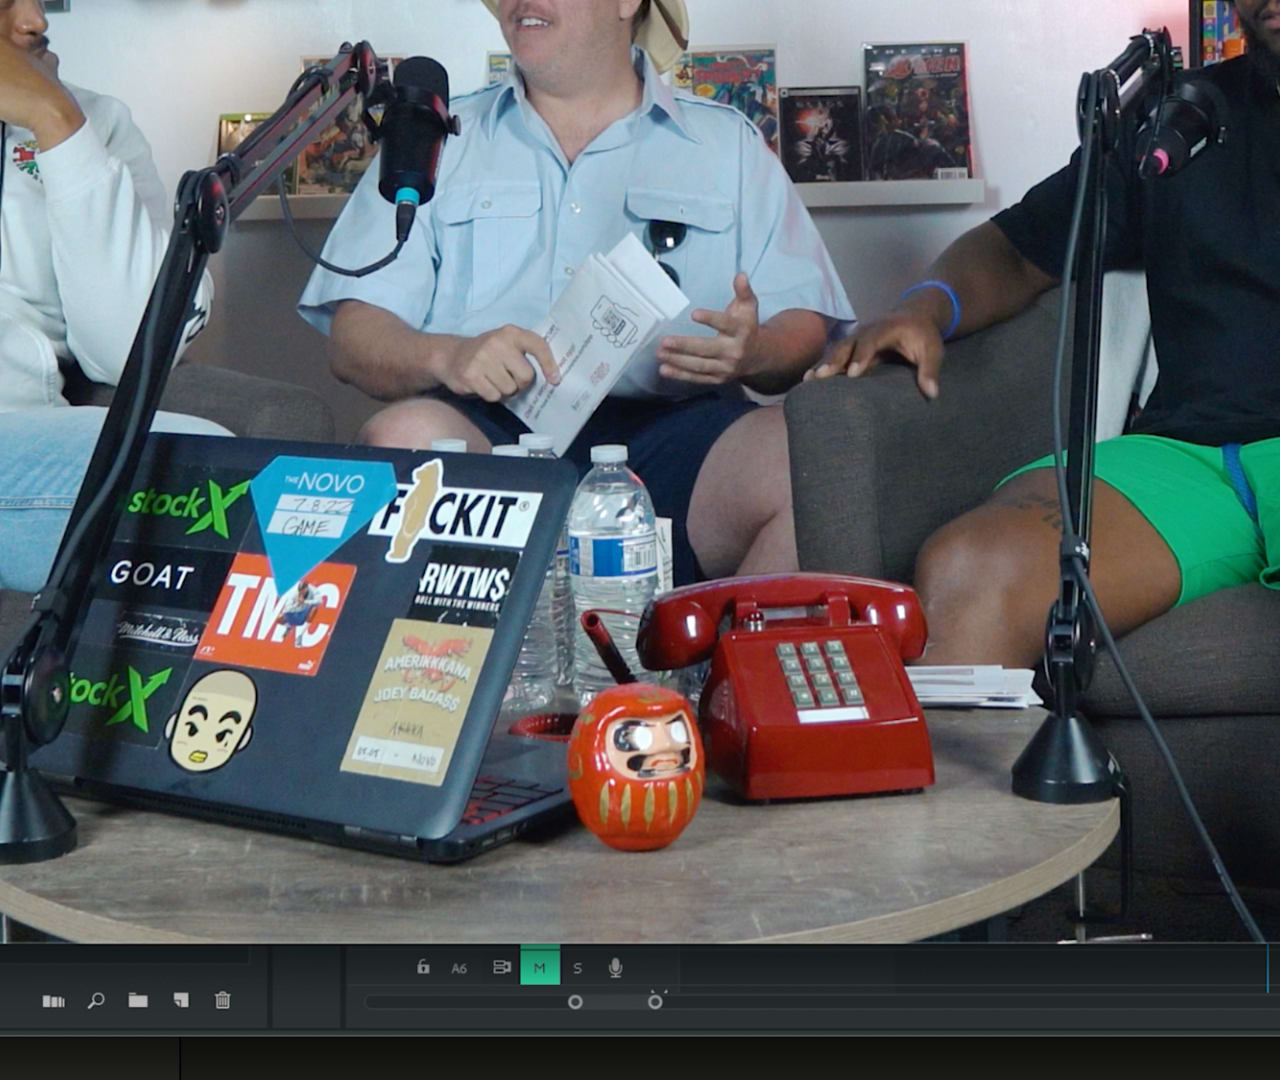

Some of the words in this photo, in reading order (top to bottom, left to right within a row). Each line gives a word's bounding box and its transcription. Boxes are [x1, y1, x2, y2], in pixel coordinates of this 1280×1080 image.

[297, 472, 365, 494] NOVO
[380, 489, 518, 538] FCKIT
[282, 515, 331, 537] GAME
[110, 560, 195, 590] GOAT
[419, 562, 510, 601] RWTW$
[216, 572, 340, 648] TMC
[373, 687, 406, 702] JOEY
[452, 963, 467, 974] A6
[534, 963, 544, 972] M
[574, 963, 582, 974] S
